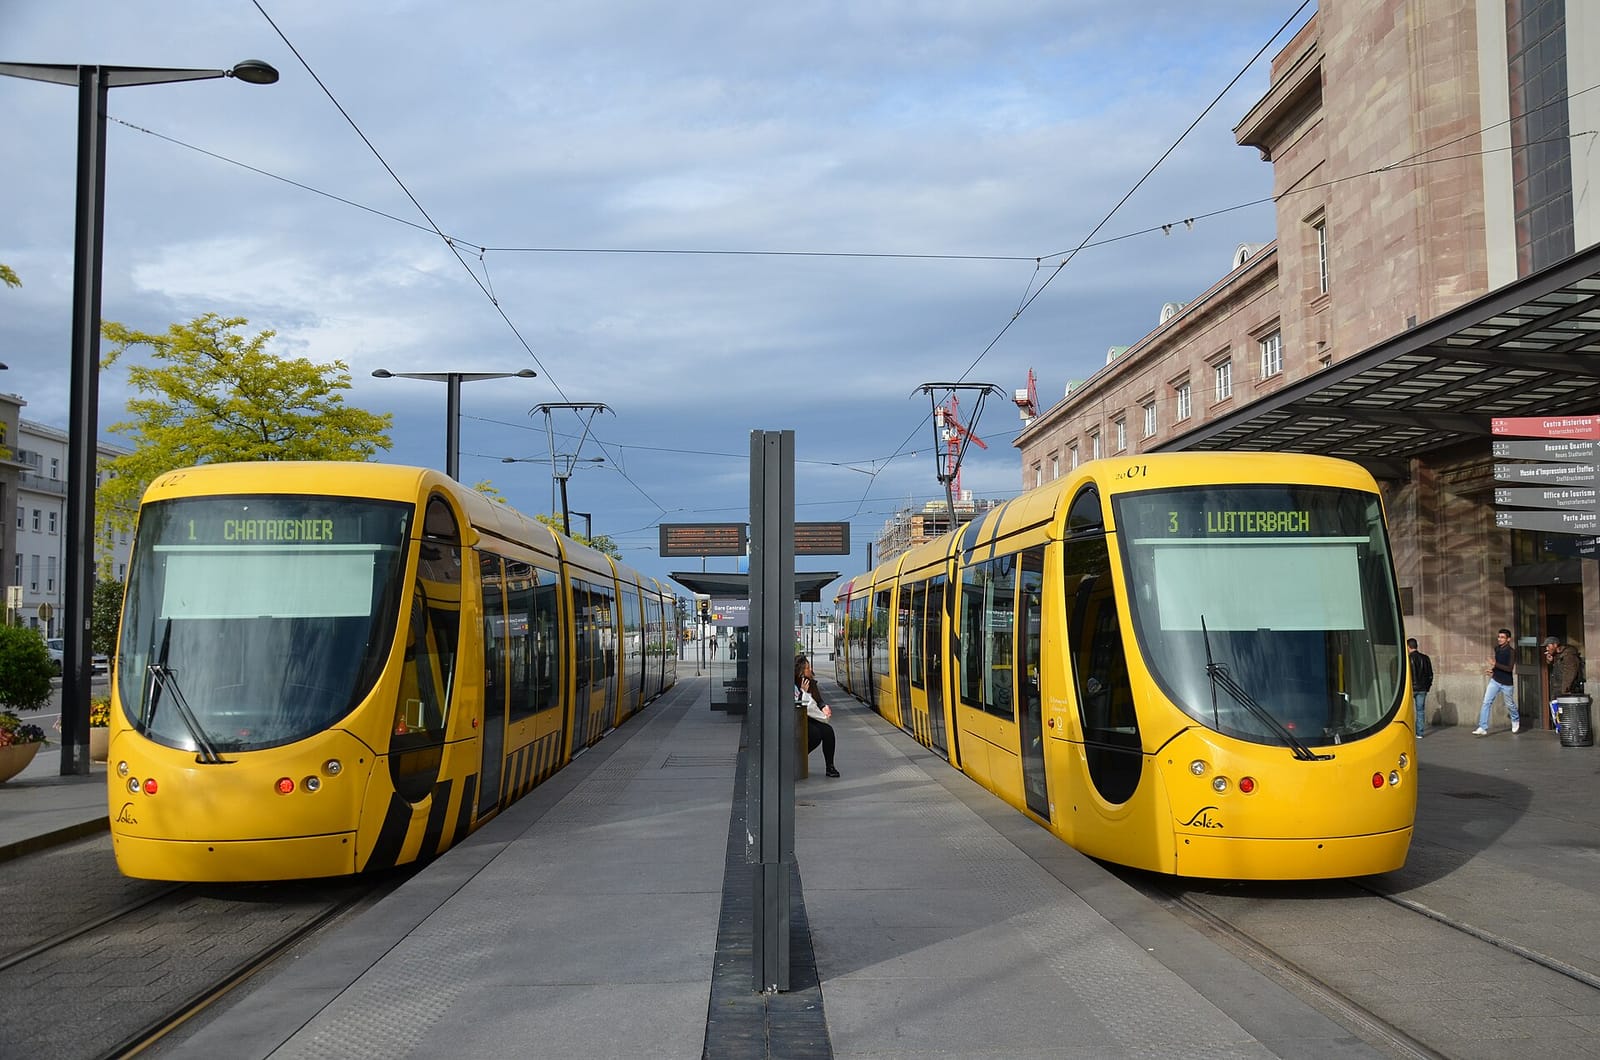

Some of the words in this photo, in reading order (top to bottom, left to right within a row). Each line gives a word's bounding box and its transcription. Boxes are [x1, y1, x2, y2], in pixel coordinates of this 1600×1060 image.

[1543, 490, 1560, 499] Office
[1569, 489, 1596, 498] Tourisme
[1168, 511, 1179, 533] 3
[1207, 511, 1310, 533] LUTTERBACH
[1562, 514, 1579, 522] Porte
[188, 519, 197, 540] 1
[223, 519, 334, 541] CHATAIGNIER
